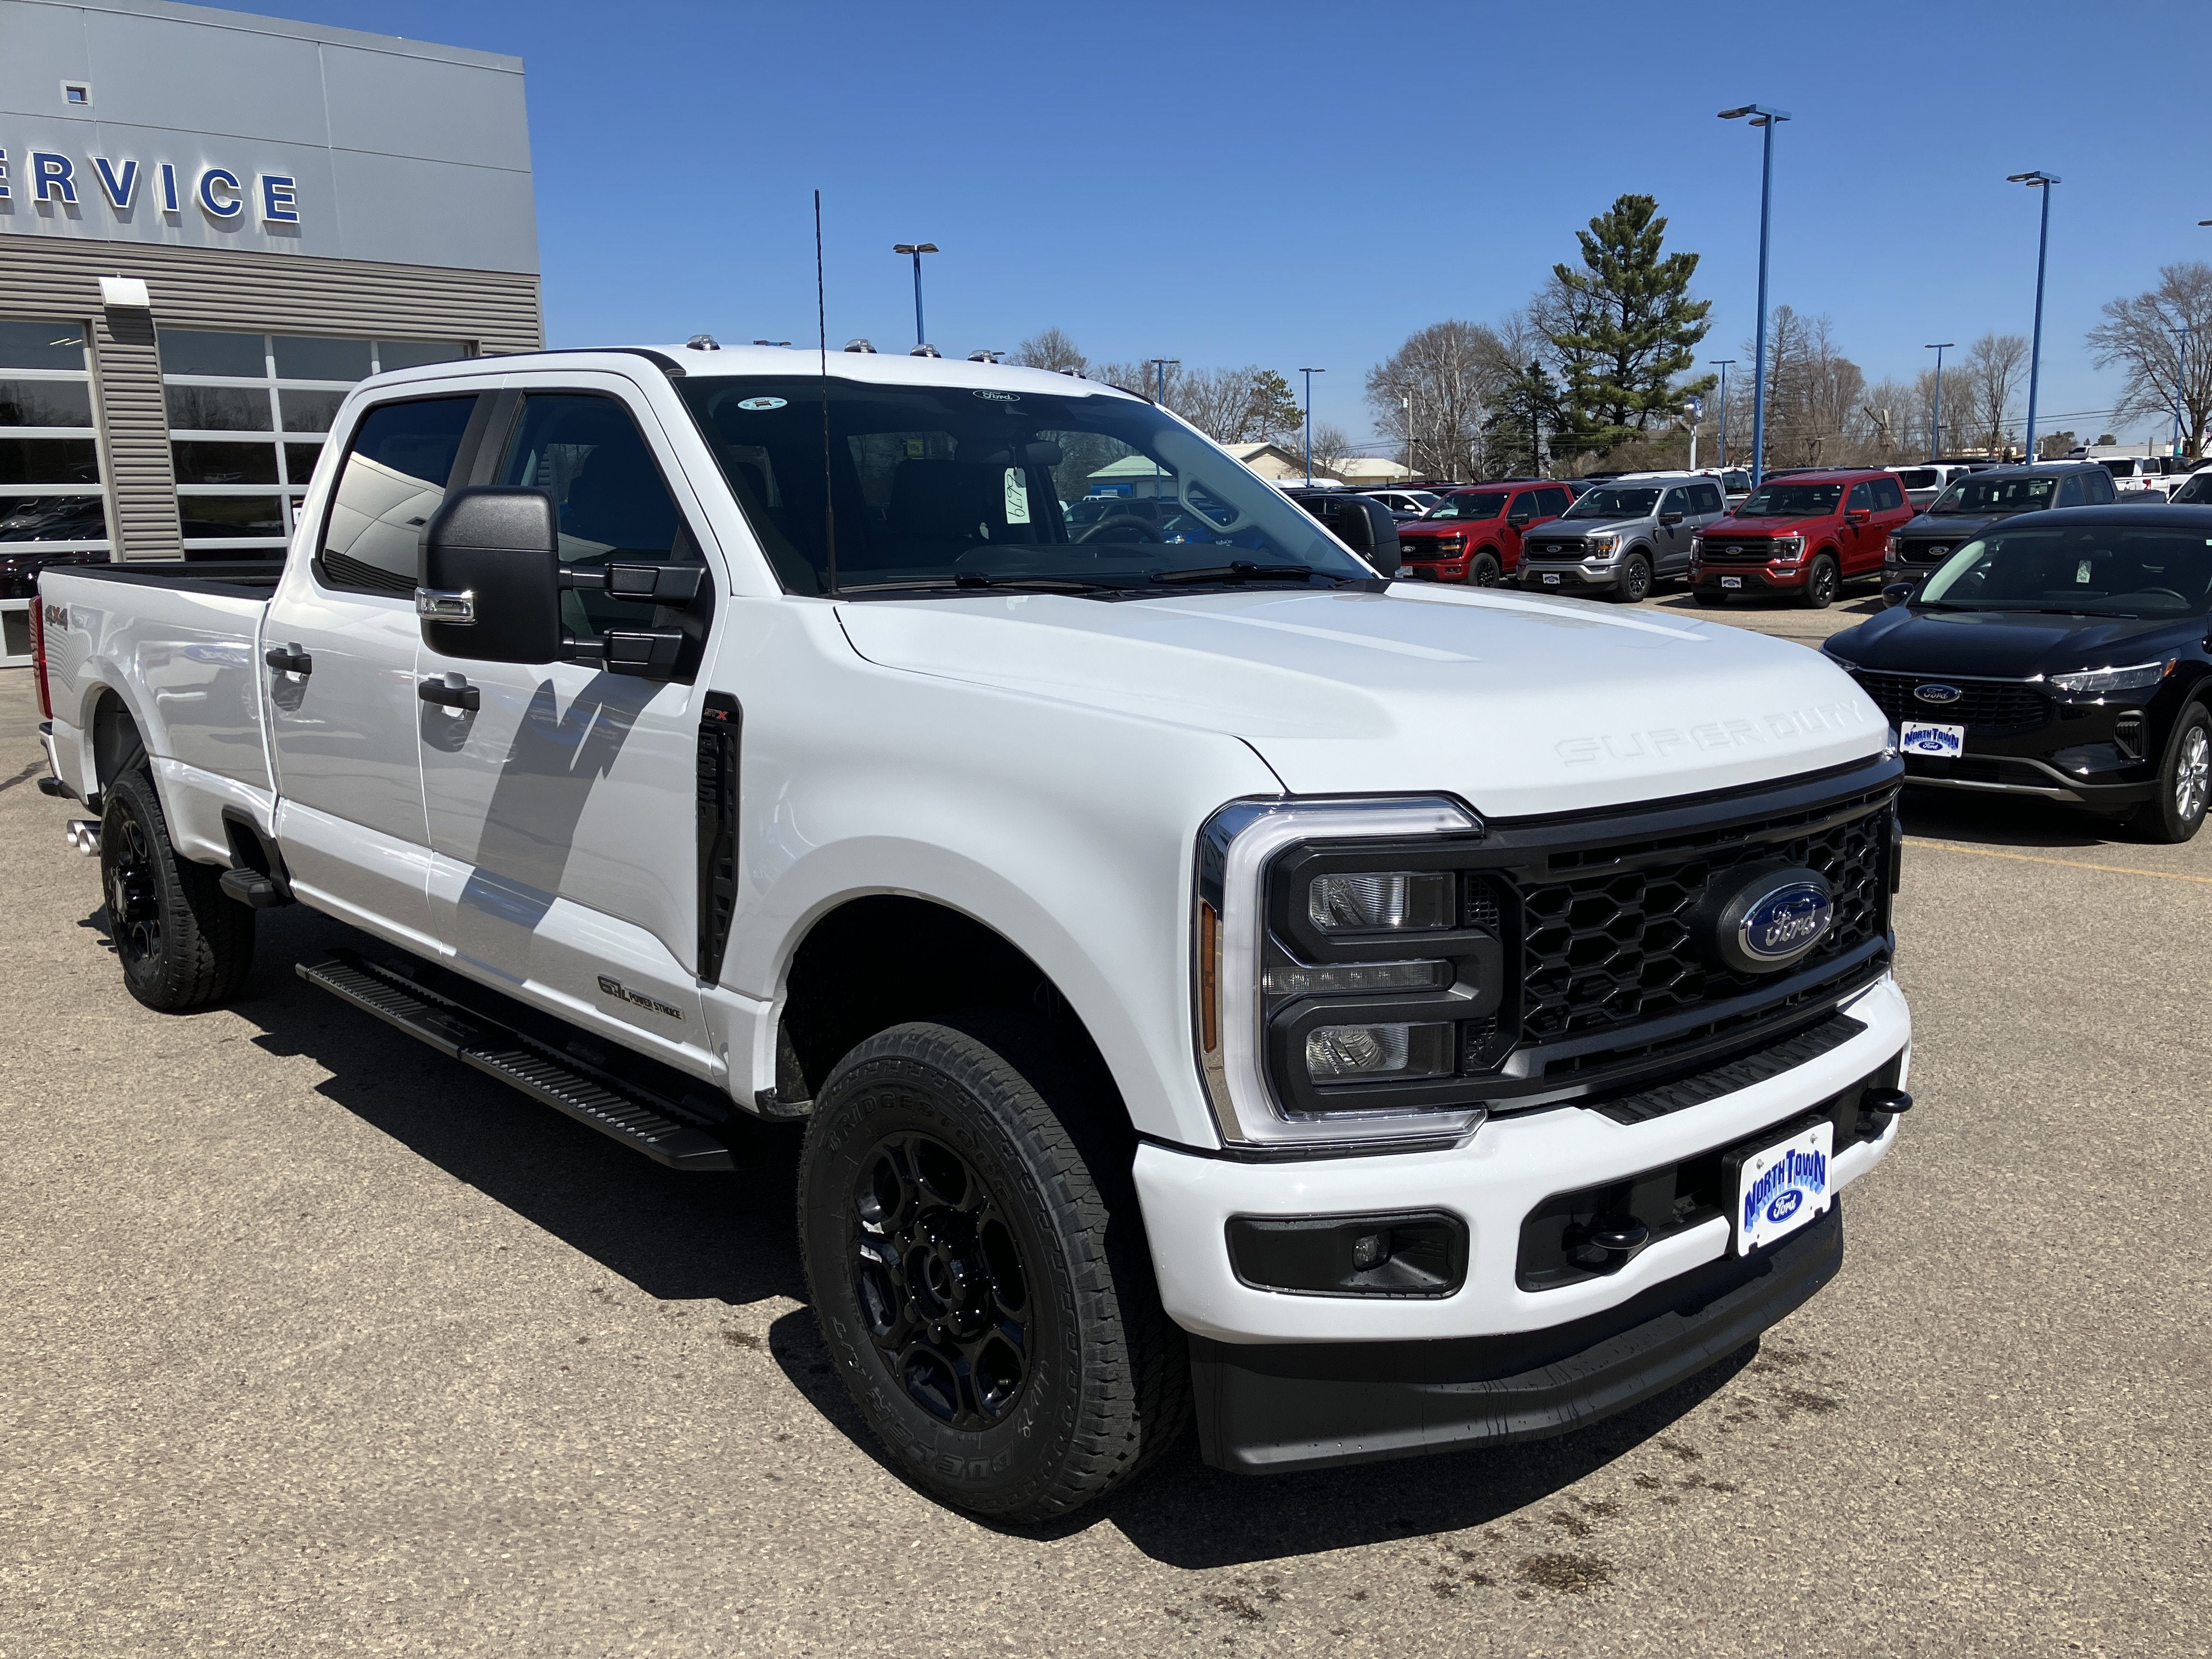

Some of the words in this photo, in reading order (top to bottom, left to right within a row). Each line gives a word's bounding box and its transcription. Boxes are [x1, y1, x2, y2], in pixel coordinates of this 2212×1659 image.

[0, 147, 301, 224] RVICE
[982, 391, 1013, 400] Ford
[1007, 473, 1025, 517] 6679
[1923, 687, 1949, 700] Ford
[1554, 719, 1767, 768] SUPER
[1763, 699, 1865, 738] DUTY
[1765, 898, 1817, 946] Ford
[629, 991, 653, 1009] POWER
[654, 1001, 682, 1020] STROKE
[823, 1091, 1012, 1201] BRIDGESTONE
[1773, 1193, 1797, 1219] Ford
